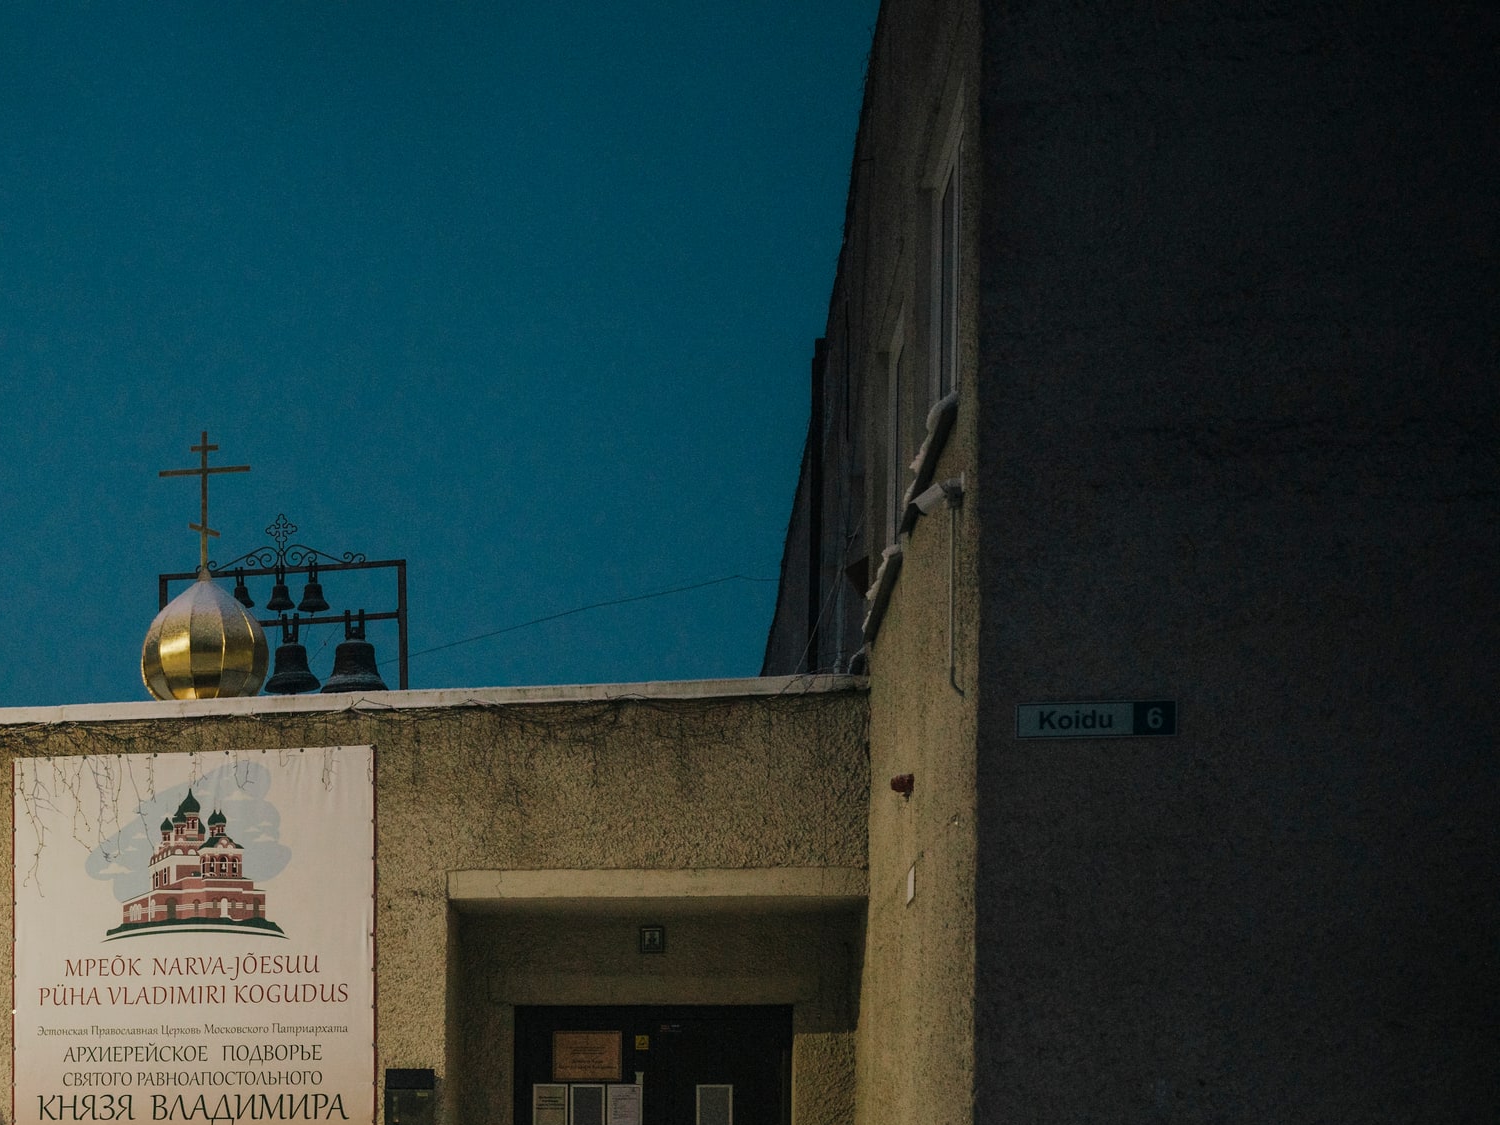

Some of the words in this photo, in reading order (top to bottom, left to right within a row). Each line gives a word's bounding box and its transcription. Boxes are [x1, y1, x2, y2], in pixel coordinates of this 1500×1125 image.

[1039, 710, 1113, 730] Koidu
[1147, 707, 1163, 728] 6
[65, 954, 140, 978] MPEÕK
[152, 952, 319, 980] NARVA-JÕESUU
[38, 984, 101, 1007] PÜHA
[107, 985, 226, 1006] VLADIMIRI
[234, 982, 348, 1004] KOGUDUS
[37, 1026, 88, 1038] Эстонская
[91, 1025, 158, 1038] Православная
[161, 1024, 201, 1038] Церковь
[204, 1024, 269, 1036] Московского
[271, 1023, 348, 1036] Патриархата
[63, 1042, 208, 1063] АРХИЕРЕЙСКОЕ
[222, 1044, 322, 1065] ПОДВОРЬЕ
[62, 1072, 132, 1086] СВЯТОГО
[137, 1070, 322, 1086] РАВНОАПОСТОЛЬНОГО
[37, 1094, 135, 1121] КНЯЗЯ
